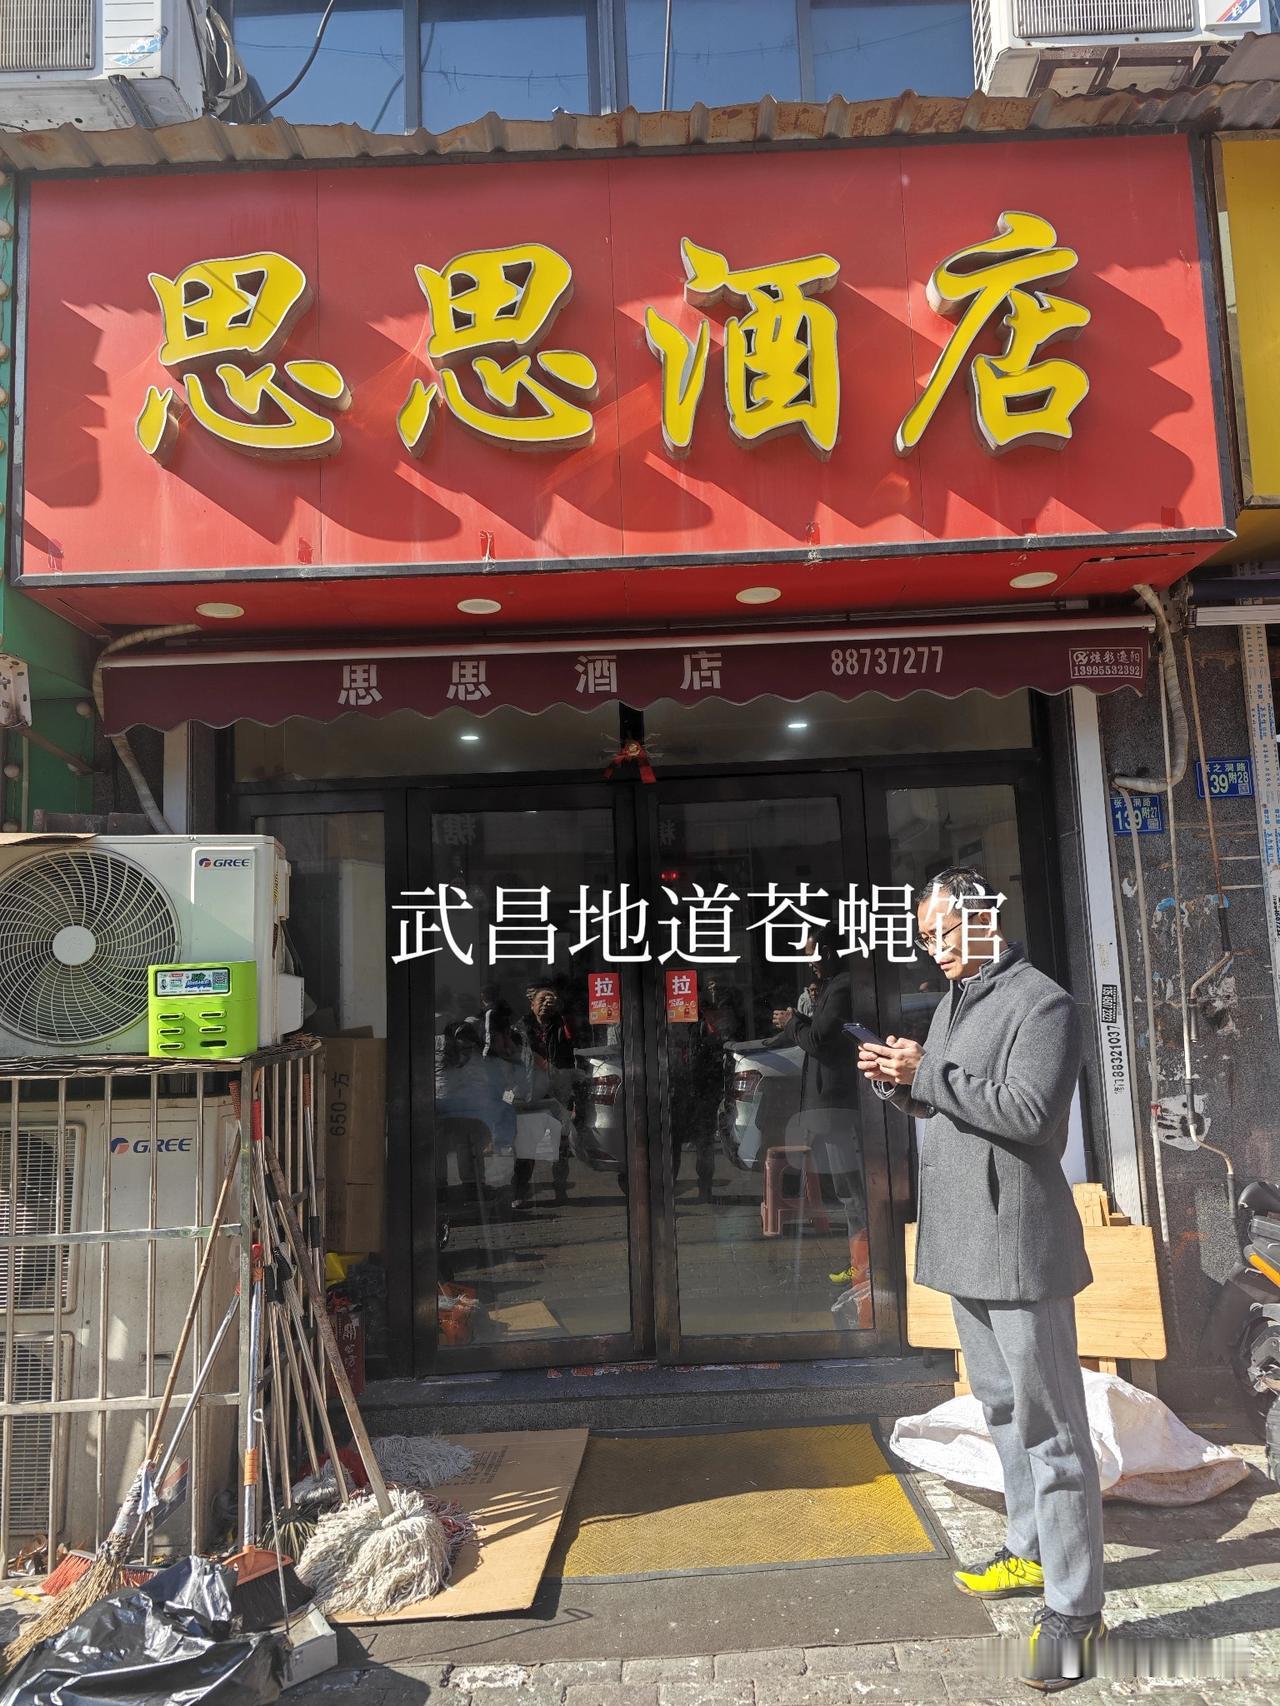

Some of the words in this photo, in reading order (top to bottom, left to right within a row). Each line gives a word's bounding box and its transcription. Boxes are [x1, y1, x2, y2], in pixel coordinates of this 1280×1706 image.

[136, 211, 1092, 458] 思思酒店
[831, 646, 944, 676] 88737277
[1074, 665, 1140, 676] 13995532392
[337, 651, 722, 706] 思思酒店
[213, 858, 250, 868] GREE
[594, 977, 615, 997] 拉
[672, 975, 692, 996] 拉
[133, 1138, 193, 1153] GREE
